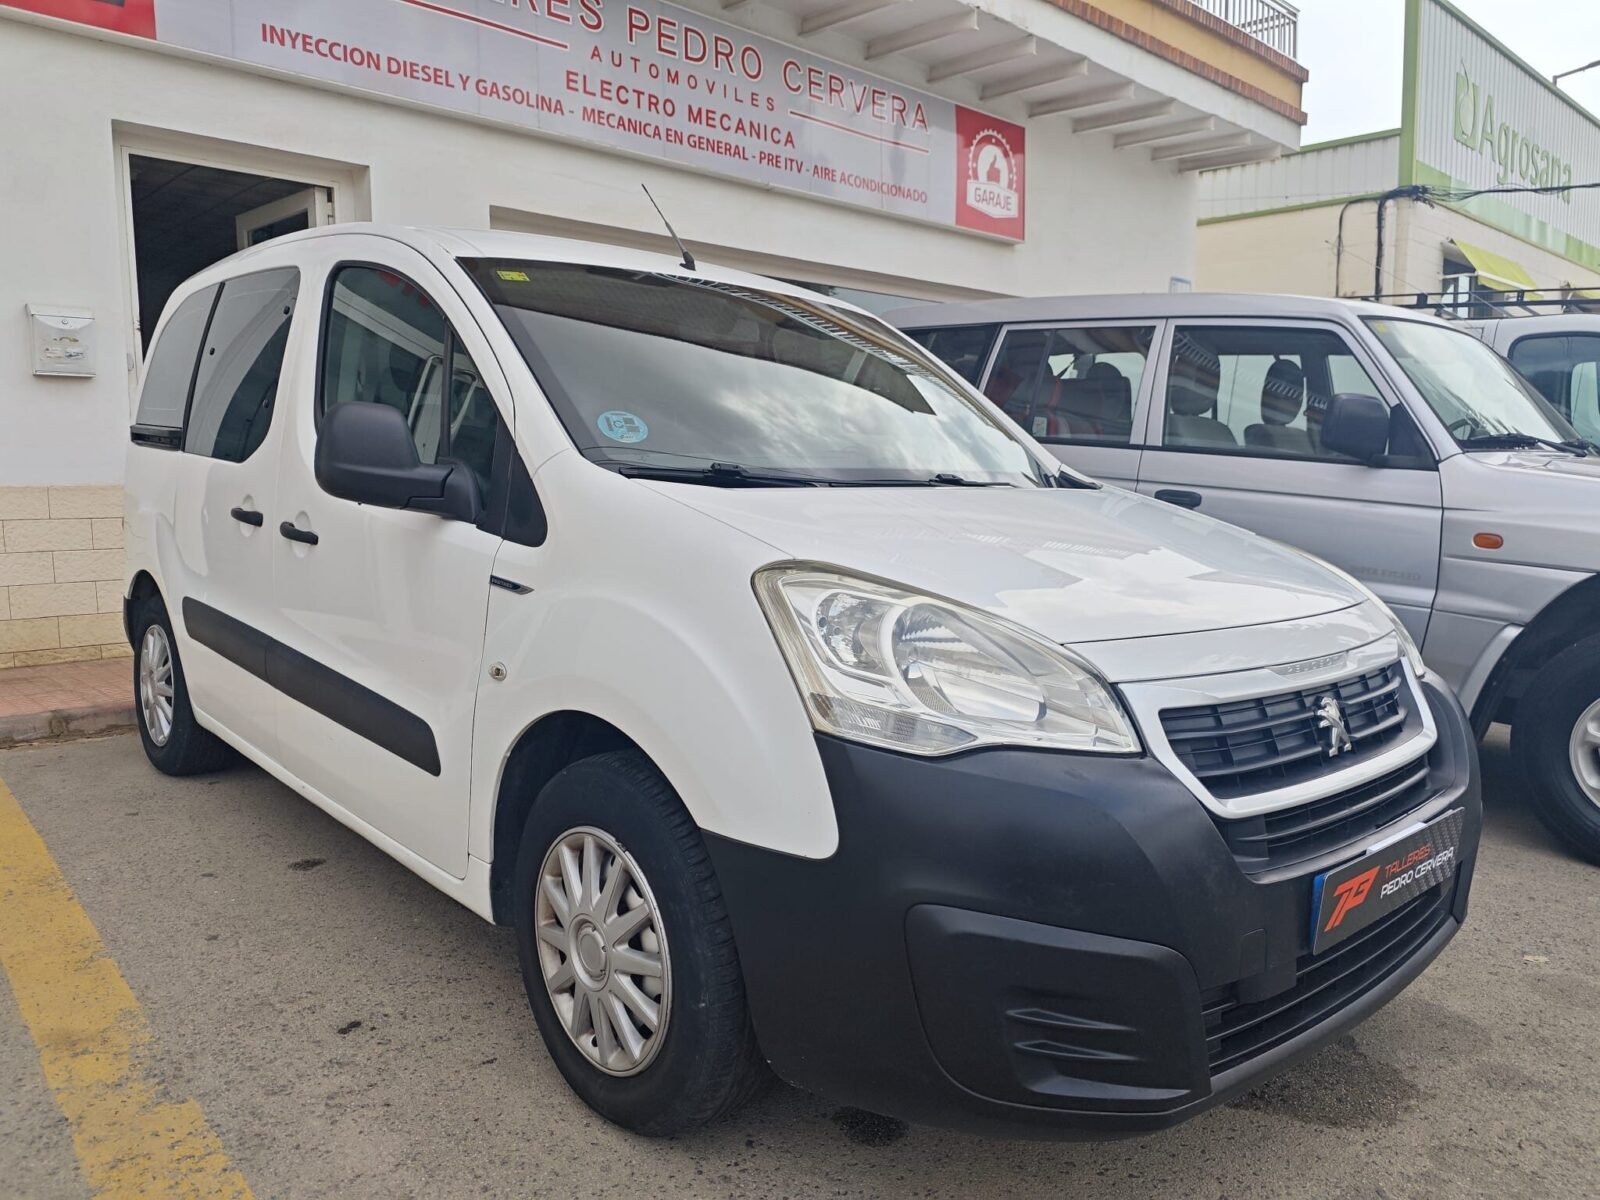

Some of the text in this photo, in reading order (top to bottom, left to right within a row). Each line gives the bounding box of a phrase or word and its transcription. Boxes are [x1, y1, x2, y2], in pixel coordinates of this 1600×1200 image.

[591, 45, 775, 112] AUTOMOVILES
[627, 6, 763, 81] PEDRO
[782, 60, 929, 132] CERVERA
[261, 23, 381, 71] INYECCION
[387, 56, 454, 89] DIESEL
[458, 73, 471, 91] Y
[475, 79, 564, 116] GASOLINA
[582, 106, 662, 141] MECANICA
[666, 128, 684, 146] EN
[687, 134, 749, 161] GENERAL
[759, 151, 782, 169] PRE
[785, 157, 804, 174] ITV
[812, 165, 837, 183] AIRE
[839, 171, 929, 204] ACONDICIONADO
[565, 70, 795, 149] ELECTRO MECANICA
[1479, 94, 1572, 206] Agrosana
[974, 187, 1013, 211] GARAJE
[1380, 846, 1454, 899] PEDRO CERVERA
[1384, 843, 1432, 879] TALLERES
